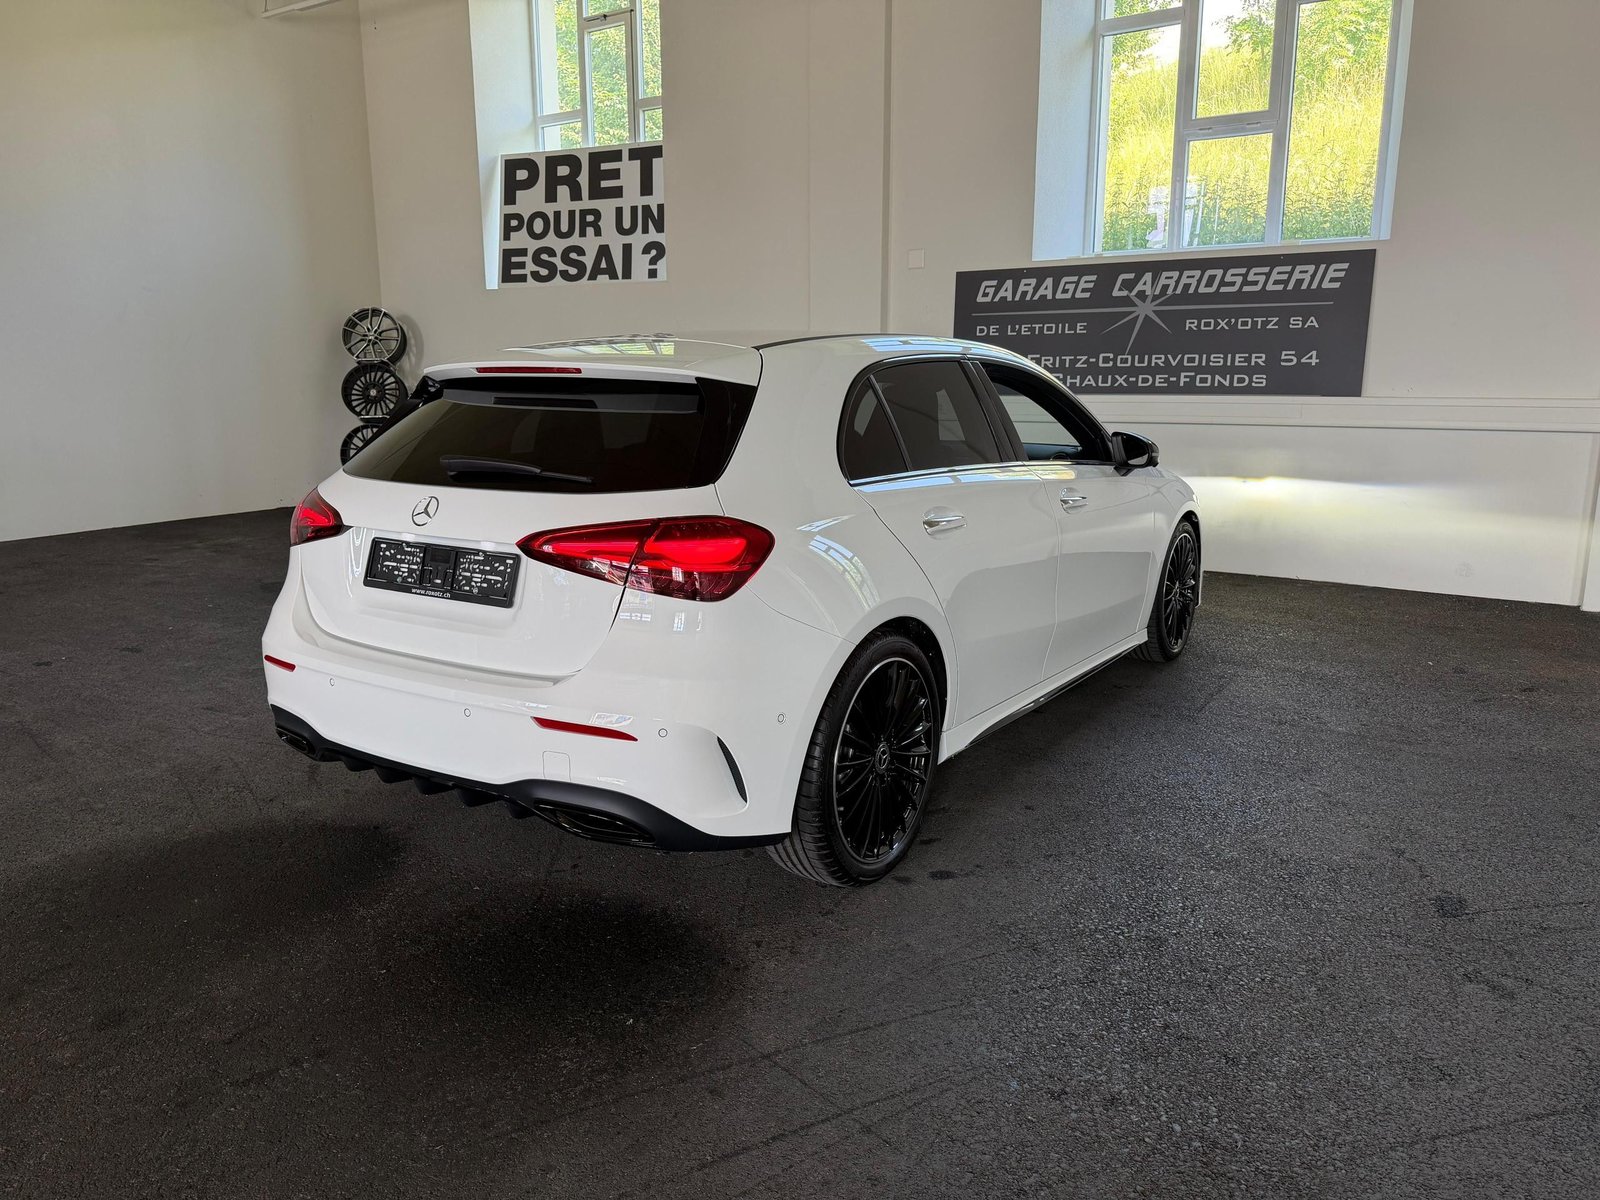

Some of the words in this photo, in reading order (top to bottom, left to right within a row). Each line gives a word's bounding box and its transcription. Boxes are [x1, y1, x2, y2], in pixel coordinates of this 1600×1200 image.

[503, 145, 663, 206] PRET
[503, 208, 602, 241] POUR
[615, 203, 665, 236] UN
[976, 275, 1098, 303] GARAGE
[1111, 262, 1350, 297] CARROSSERIE
[976, 325, 999, 337] DE
[1007, 322, 1088, 336] L'ETOILE
[1185, 317, 1280, 331] ROX'OTZ
[1288, 316, 1320, 329] SA
[1280, 350, 1320, 367] 54
